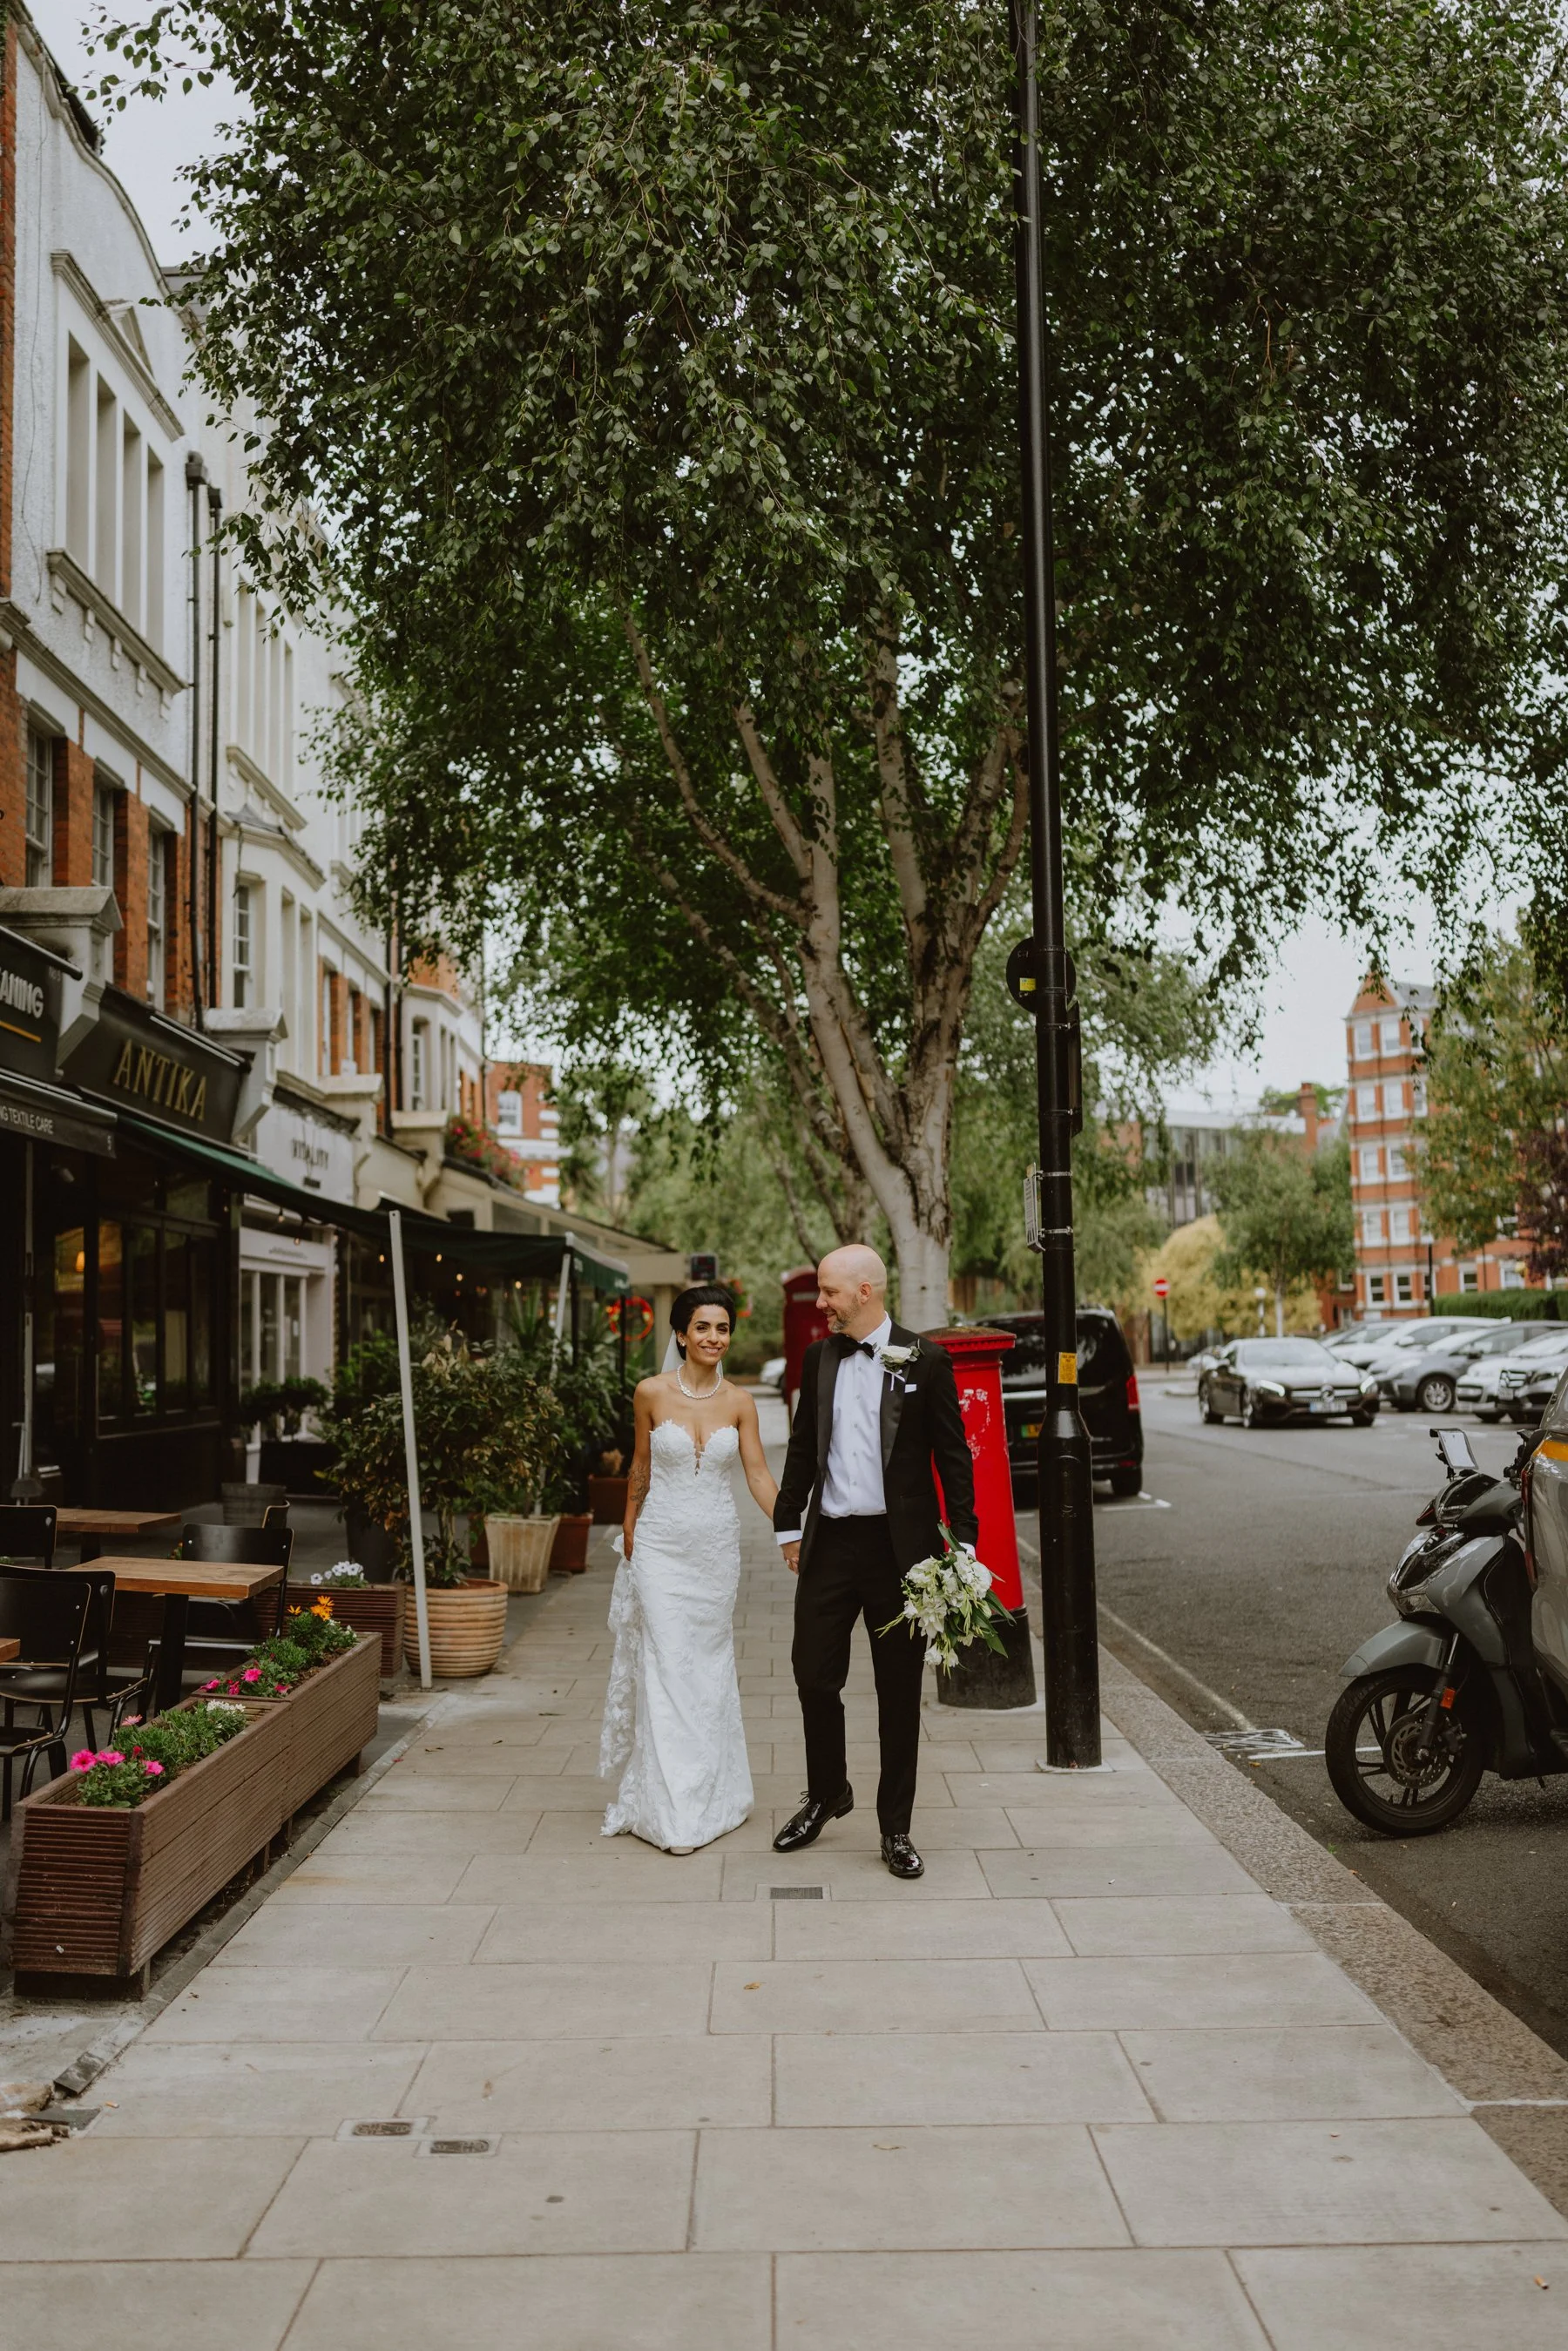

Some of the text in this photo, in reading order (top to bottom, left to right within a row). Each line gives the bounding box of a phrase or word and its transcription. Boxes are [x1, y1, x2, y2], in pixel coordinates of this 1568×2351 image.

[112, 1037, 207, 1122] ANTIKA
[8, 1106, 36, 1130] TEXTILE
[35, 1115, 54, 1135] CARE
